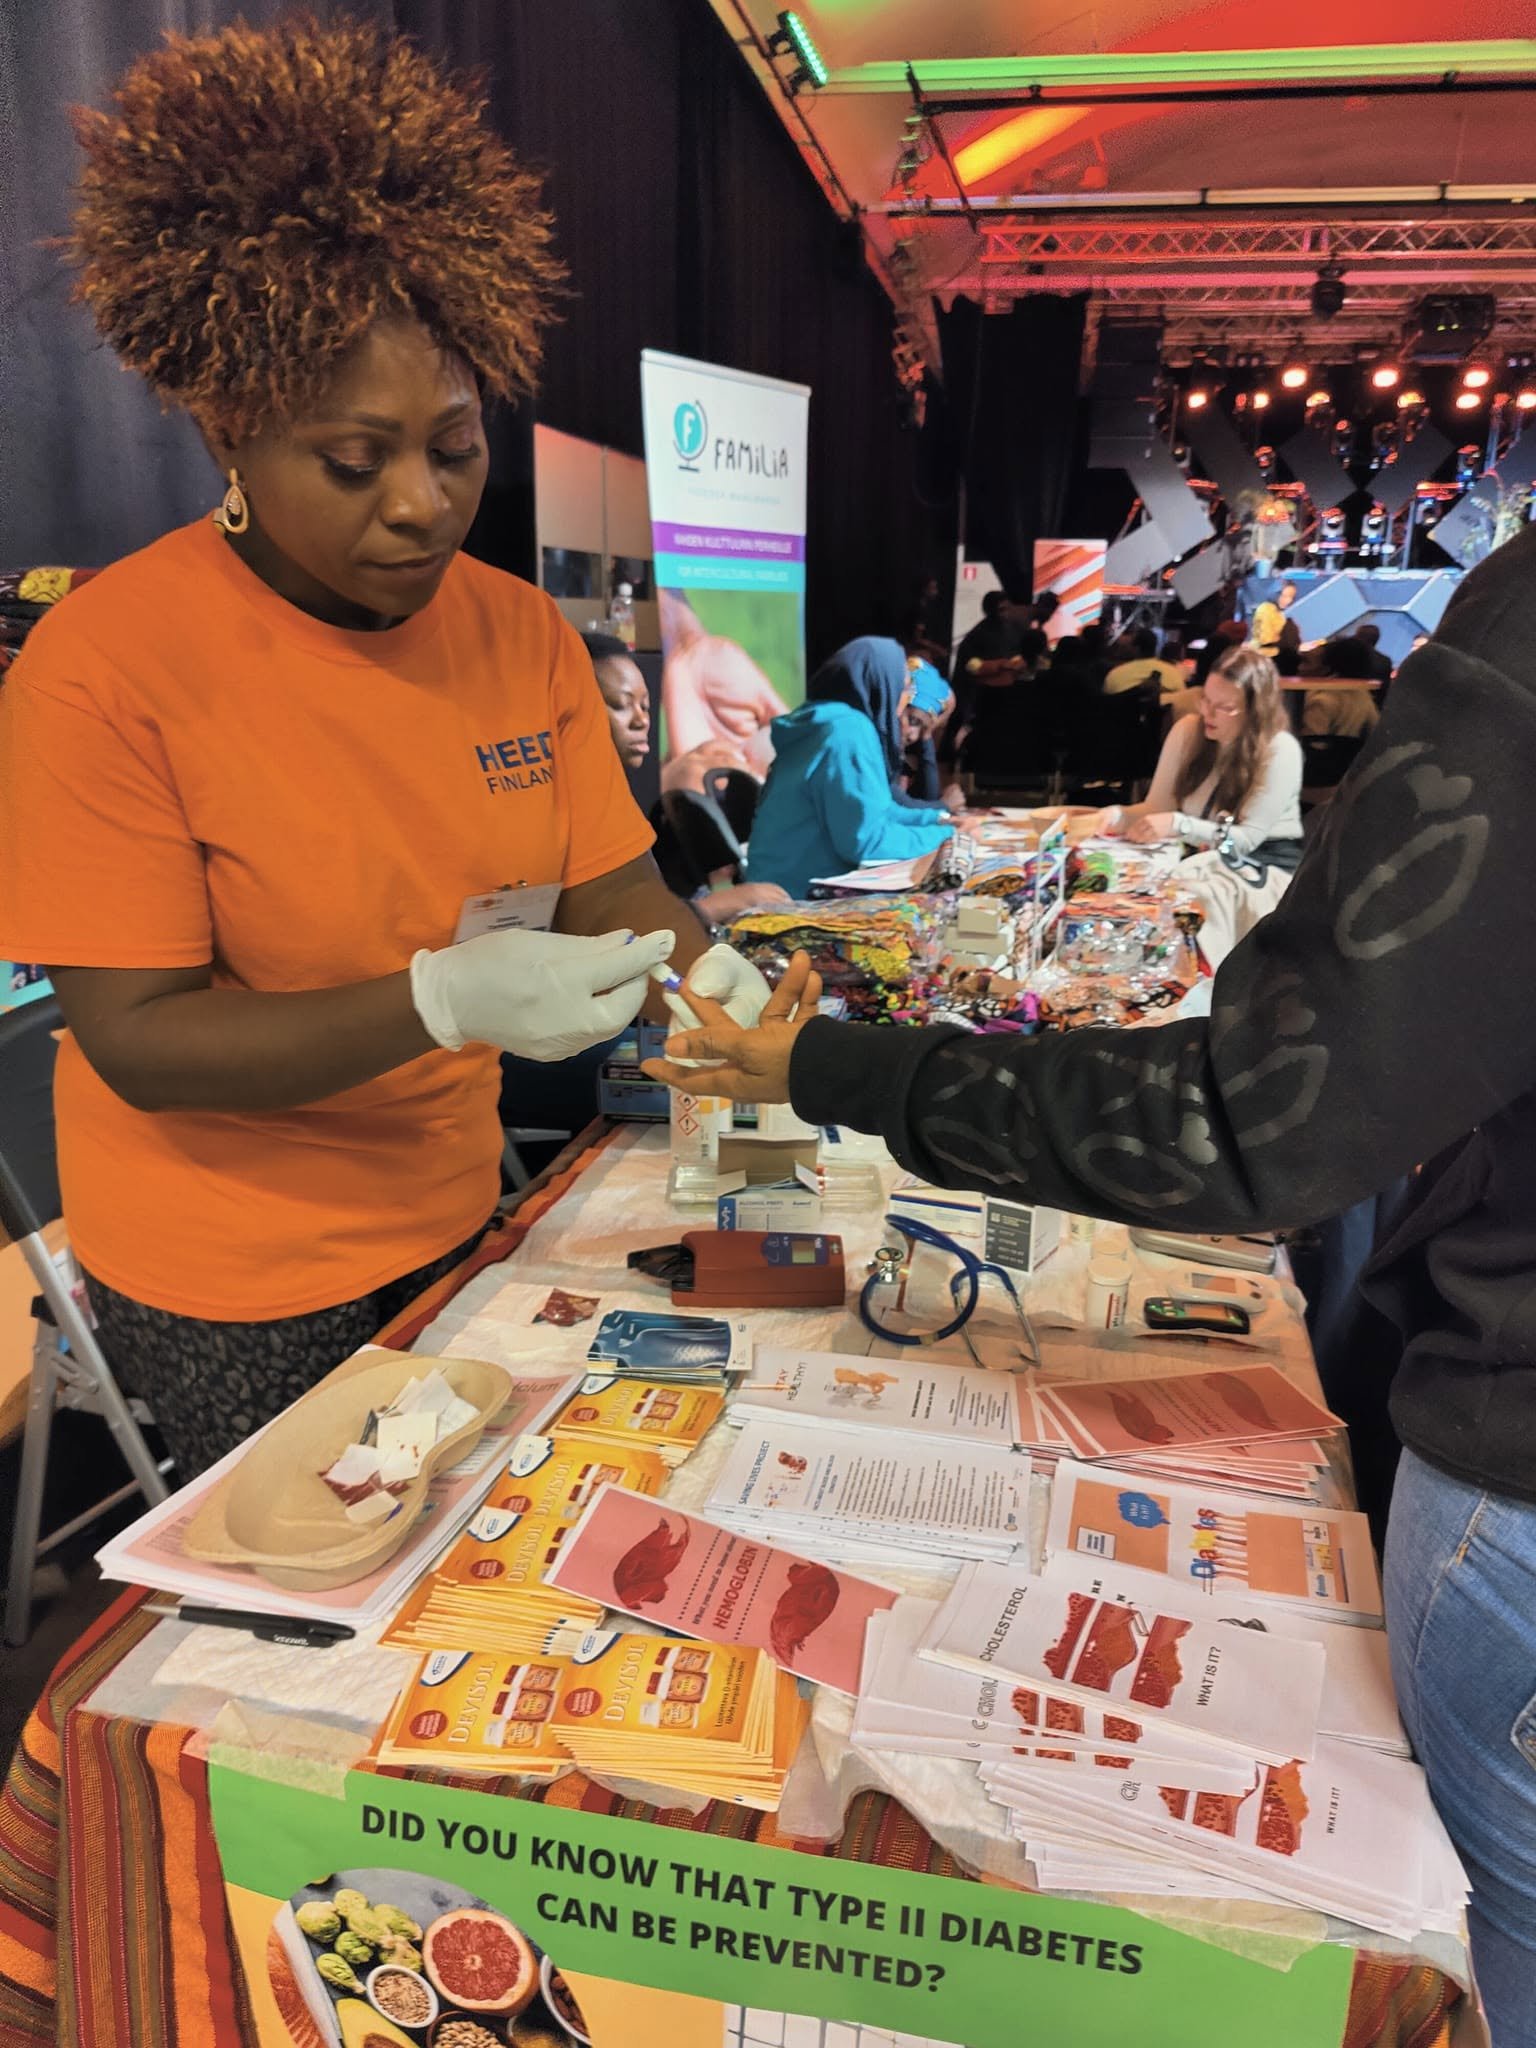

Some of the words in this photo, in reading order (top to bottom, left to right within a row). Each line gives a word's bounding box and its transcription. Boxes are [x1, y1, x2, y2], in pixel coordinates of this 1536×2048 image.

[486, 767, 553, 795] FINLAN
[713, 1545, 759, 1630] HEMOGLOBIN
[979, 1585, 1028, 1662] CHOLESTEROL
[605, 1642, 648, 1722] DEVISOL
[1196, 1676, 1214, 1706] WHAT
[1205, 1664, 1218, 1677] IS
[1208, 1646, 1222, 1664] IT?
[448, 1661, 497, 1744] DEVISOL
[361, 1804, 425, 1843] DID
[437, 1818, 519, 1862] YOU
[530, 1836, 659, 1889] KNOW
[670, 1862, 777, 1911] THAT
[787, 1884, 887, 1933] TYPE
[899, 1905, 926, 1938] II
[939, 1911, 1145, 1977] DIABETES
[536, 1892, 618, 1934] CAN
[631, 1910, 678, 1945] BE
[689, 1921, 947, 1993] PREVENTED?
